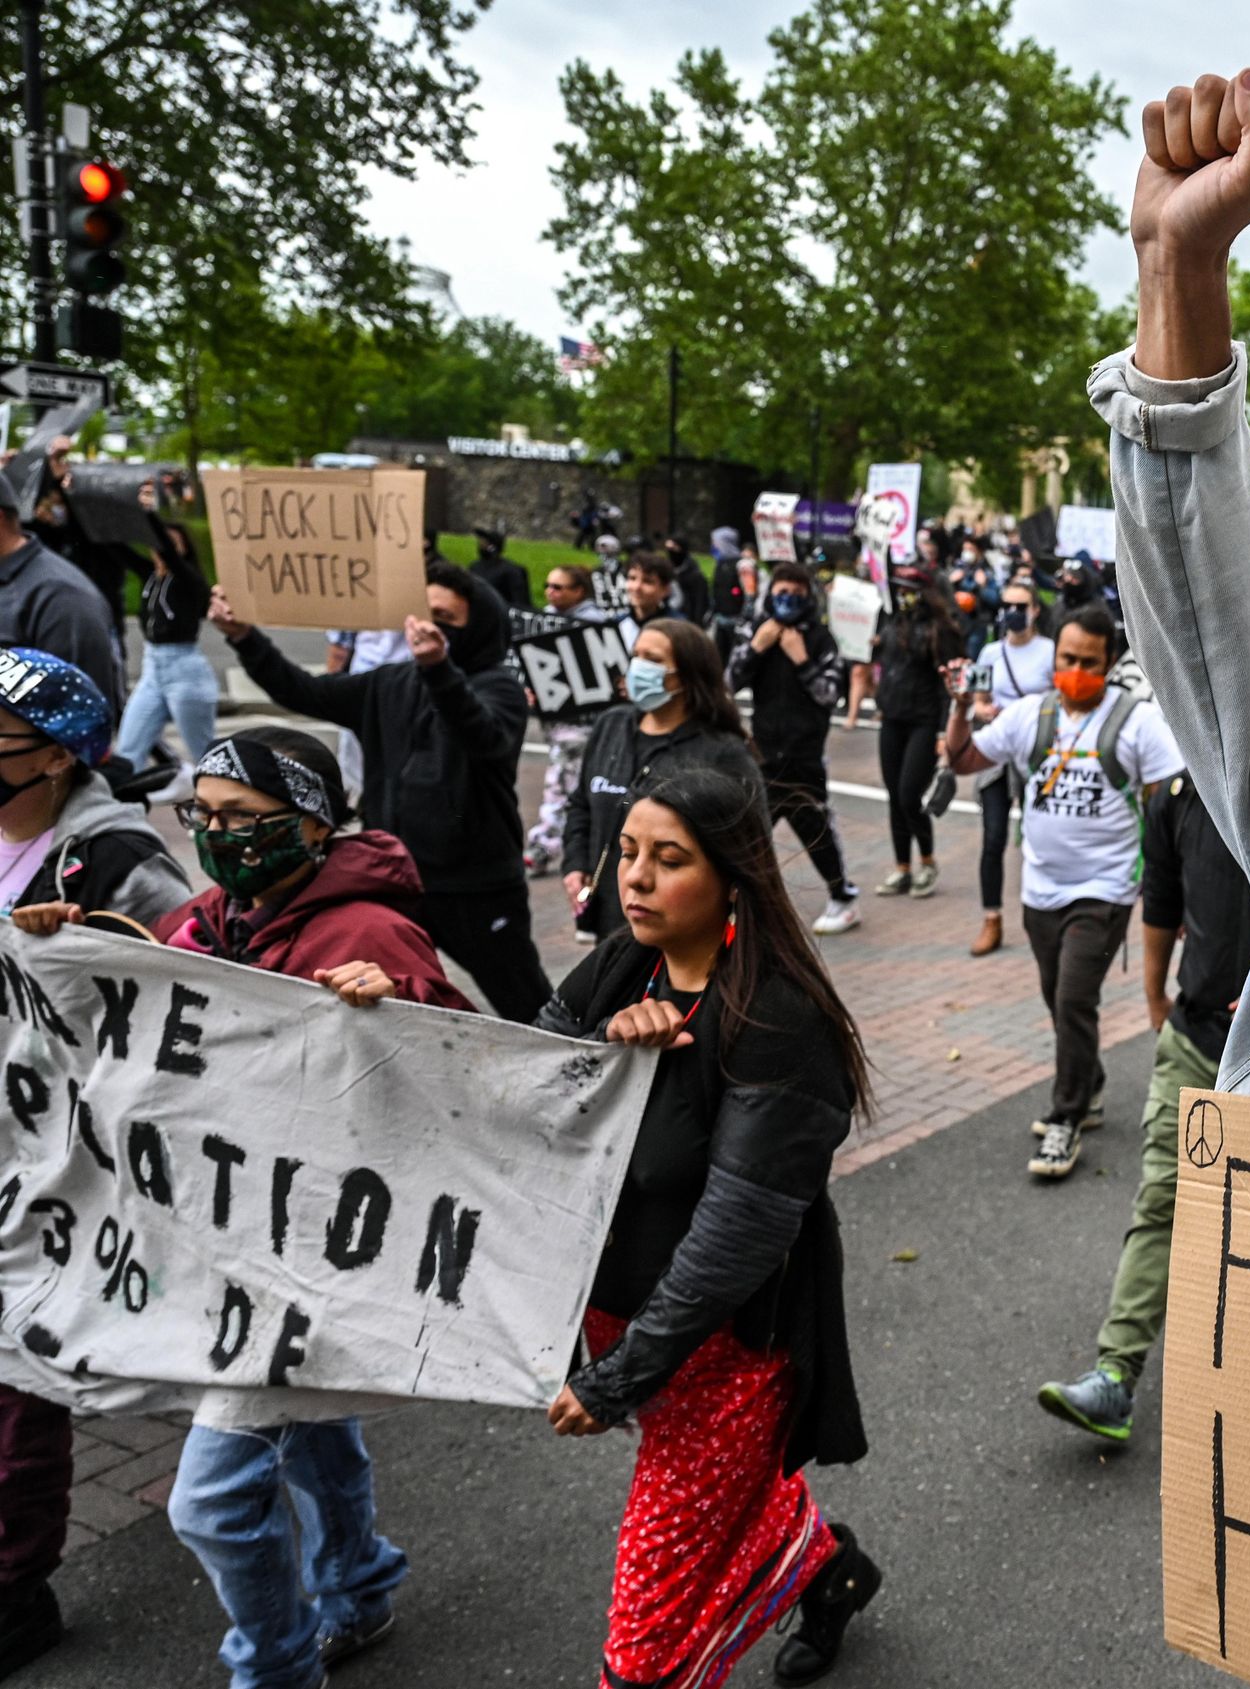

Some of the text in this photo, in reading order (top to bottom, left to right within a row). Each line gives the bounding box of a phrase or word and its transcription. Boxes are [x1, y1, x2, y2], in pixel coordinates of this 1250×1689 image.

[221, 486, 411, 549] BLACK LIVES
[245, 552, 376, 599] MATTER
[520, 626, 630, 712] BLM
